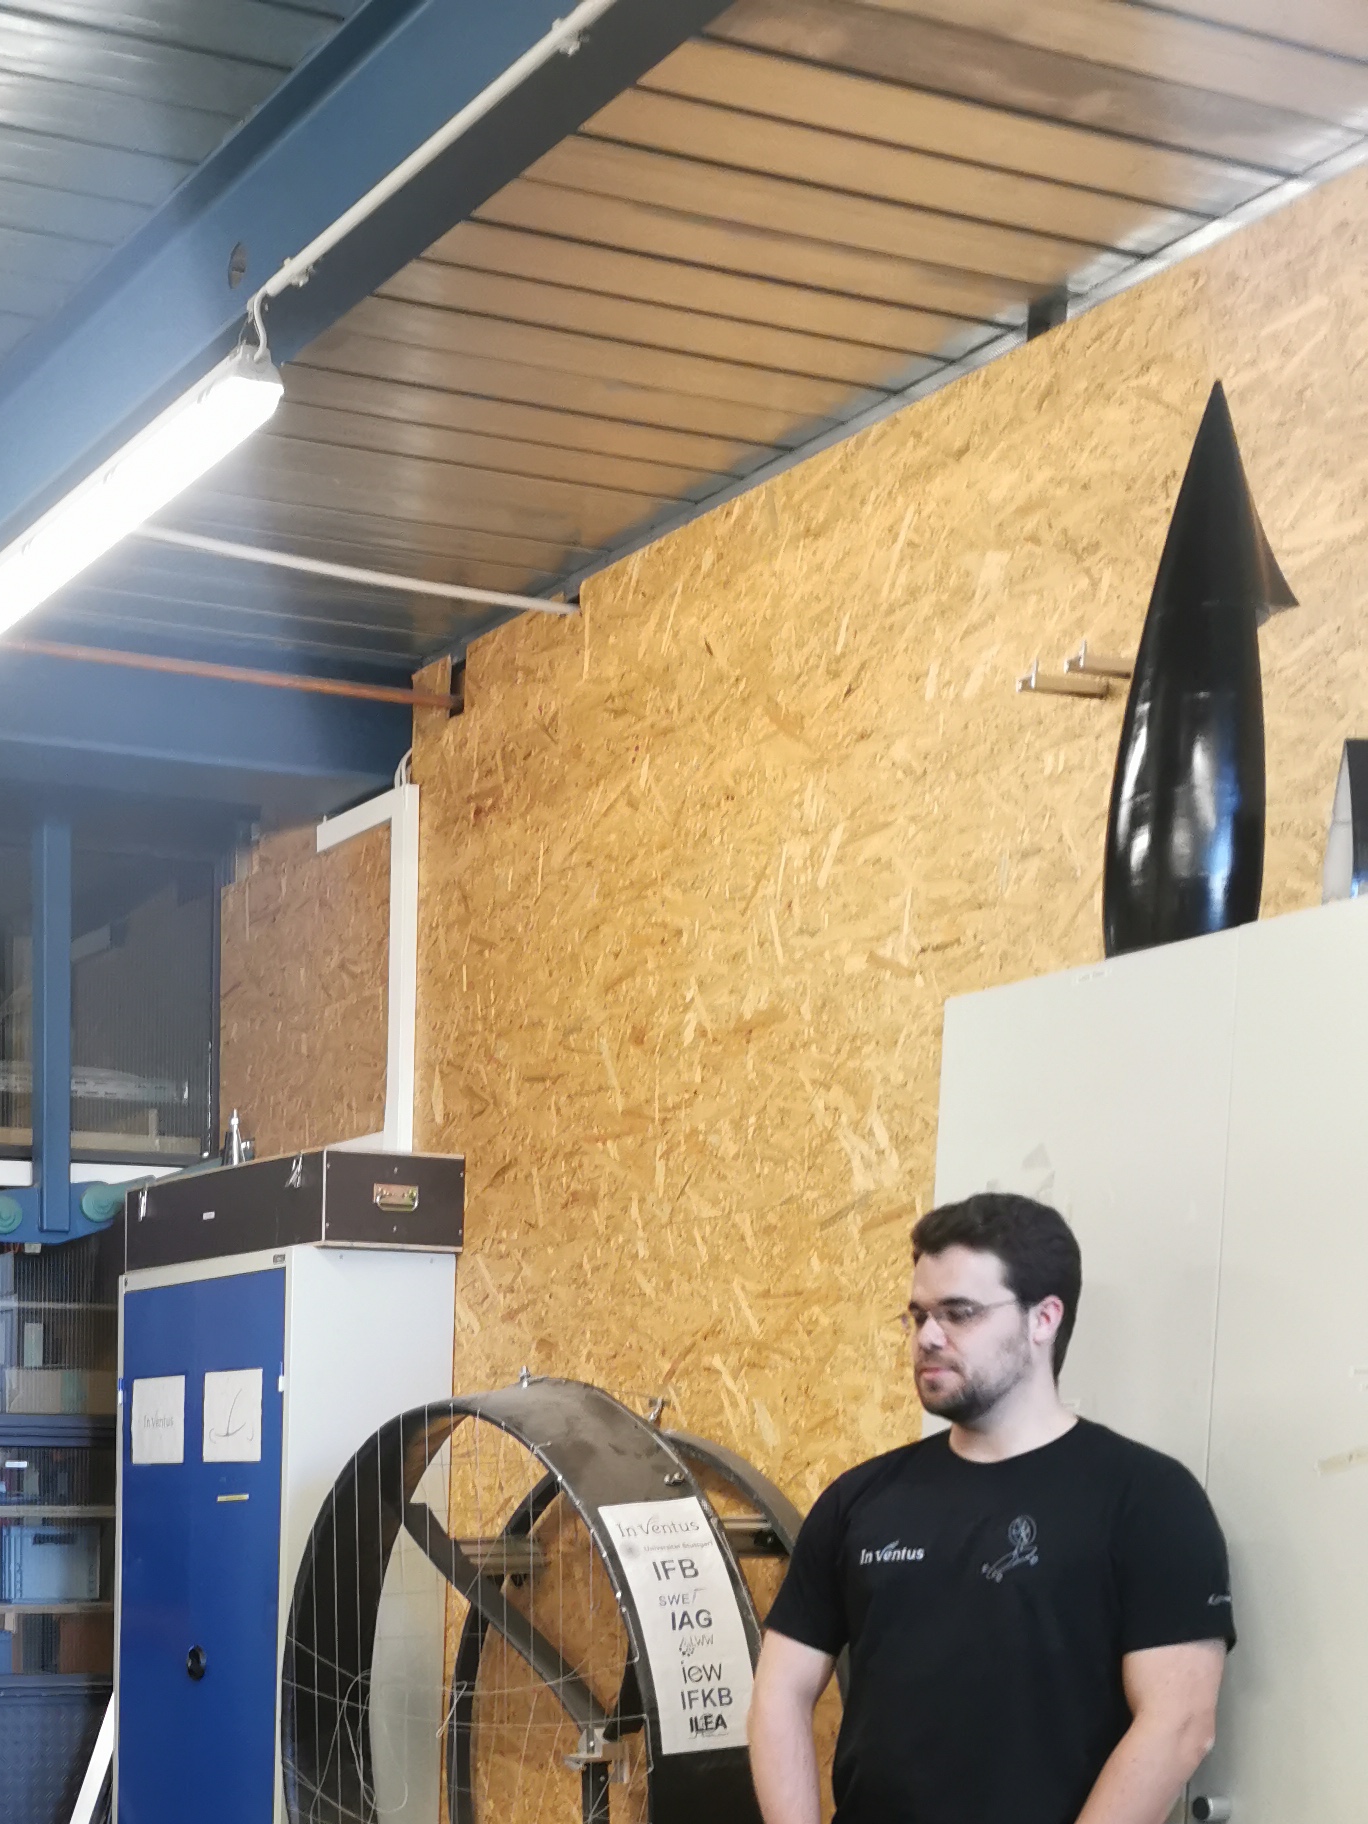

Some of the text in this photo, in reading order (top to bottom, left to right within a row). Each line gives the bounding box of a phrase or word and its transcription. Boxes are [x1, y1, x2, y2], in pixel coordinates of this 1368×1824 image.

[652, 1559, 699, 1581] IFB
[671, 1608, 712, 1631] IAG
[680, 1687, 733, 1710] IFKB
[688, 1713, 728, 1734] ILEA
